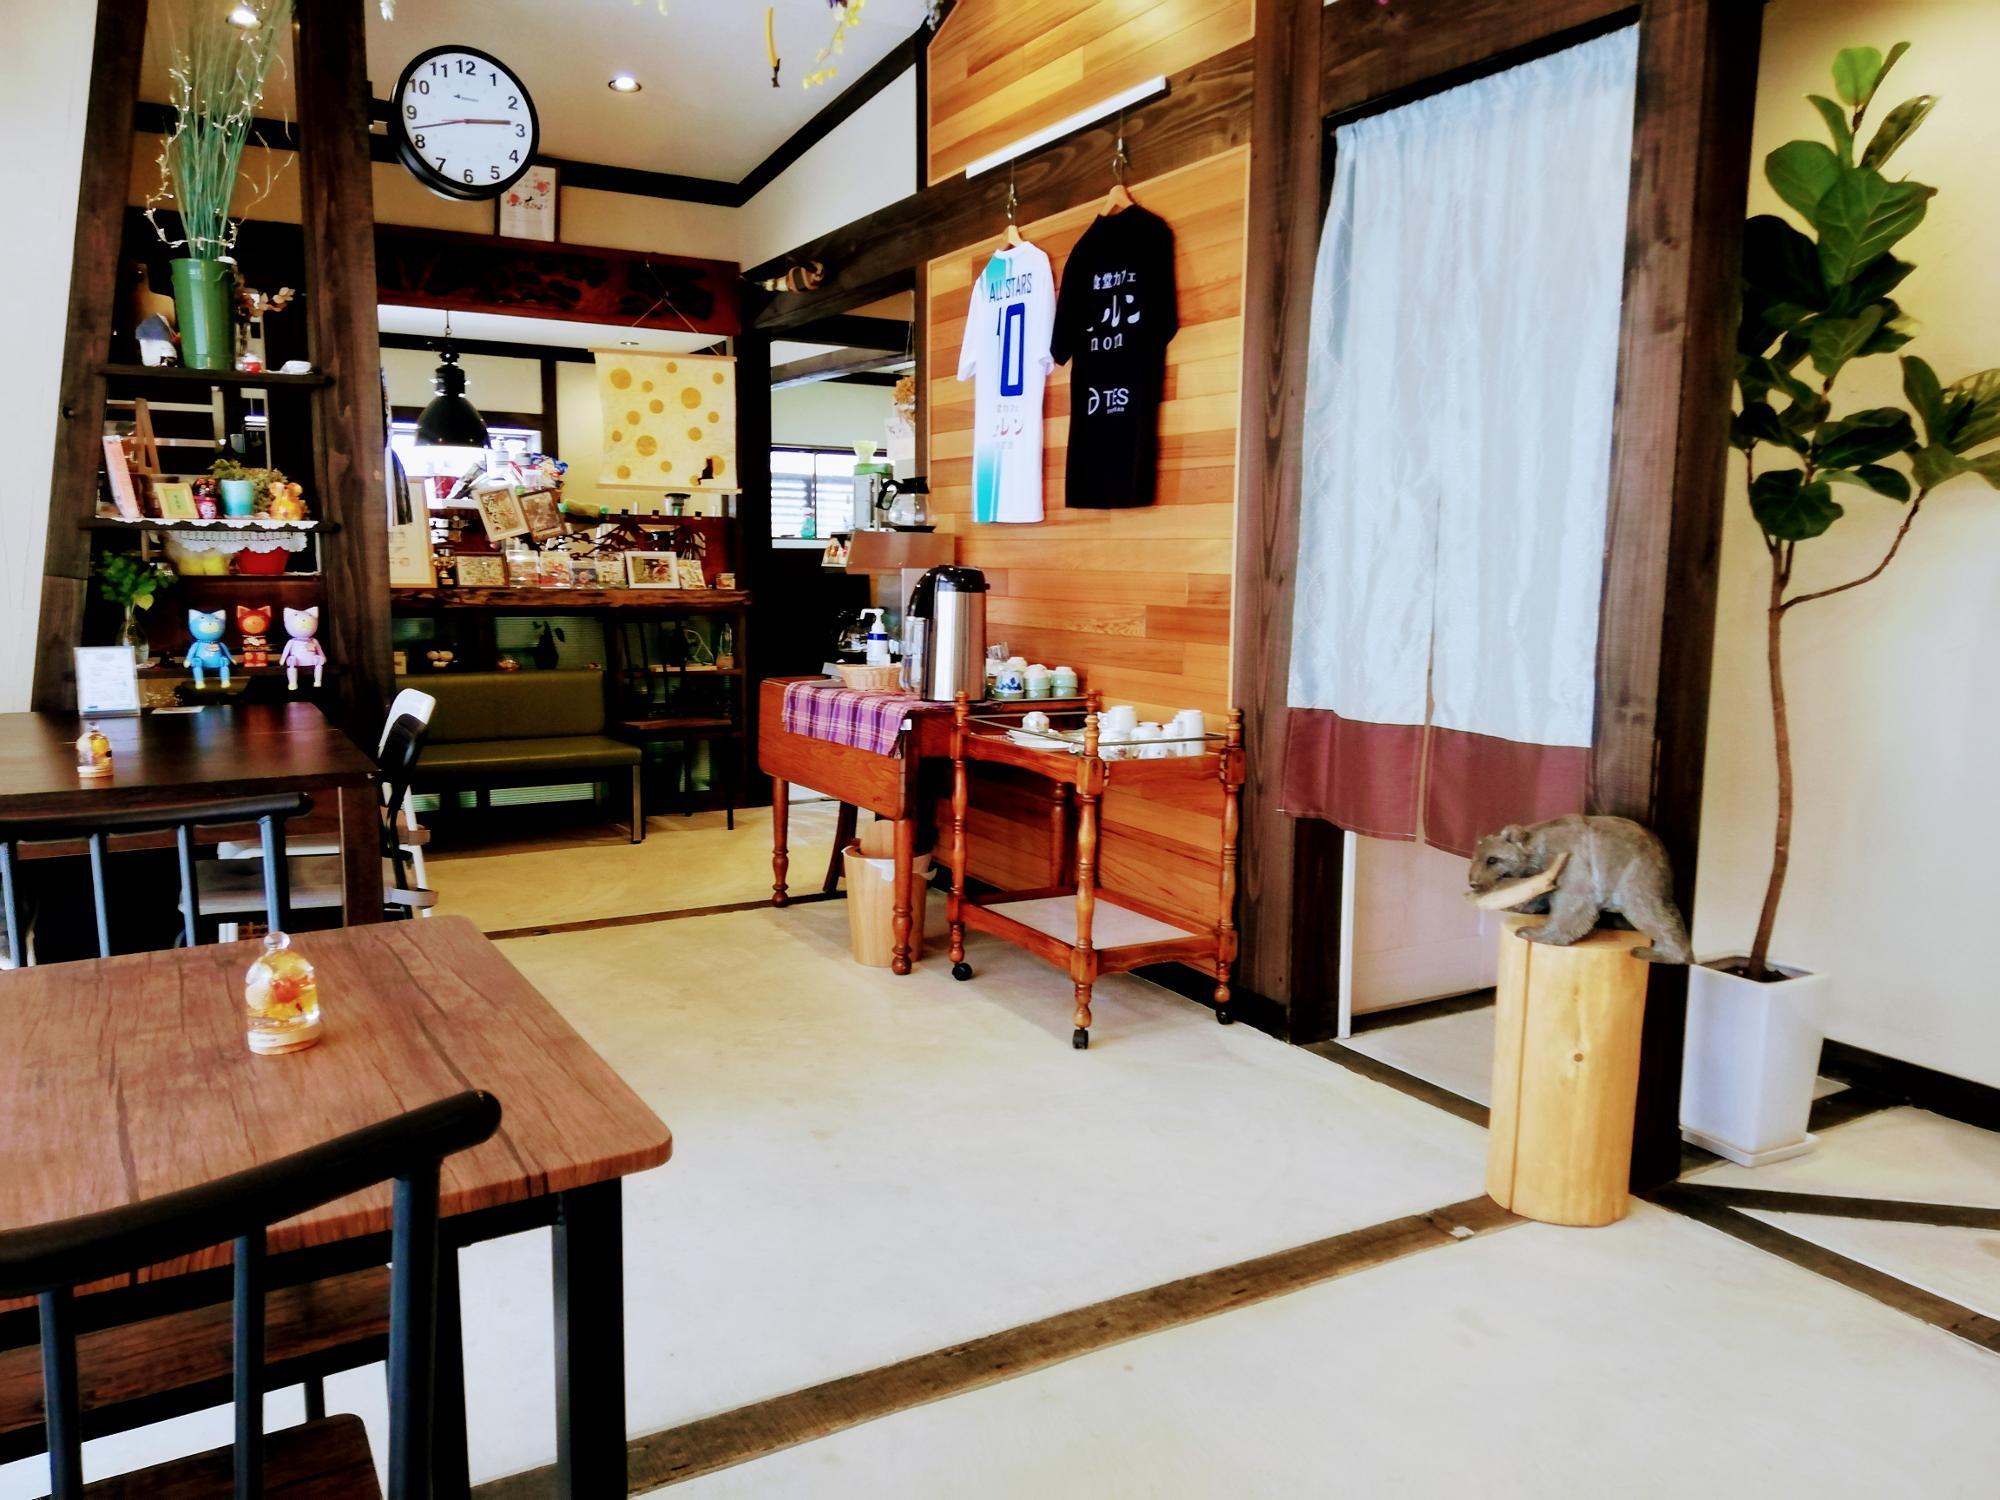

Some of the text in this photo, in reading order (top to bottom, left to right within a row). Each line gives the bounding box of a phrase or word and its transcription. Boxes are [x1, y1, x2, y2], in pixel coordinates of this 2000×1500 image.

[429, 61, 448, 78] 11
[455, 59, 477, 76] 12
[409, 78, 430, 95] 10
[489, 73, 497, 86] 1
[507, 95, 519, 110] 2
[406, 105, 418, 120] 9
[515, 123, 526, 138] 3
[414, 134, 426, 149] 8
[508, 149, 519, 163] 4
[435, 156, 447, 172] 7
[463, 169, 474, 183] 6
[490, 165, 501, 180] 5
[1005, 272, 1032, 299] STARS
